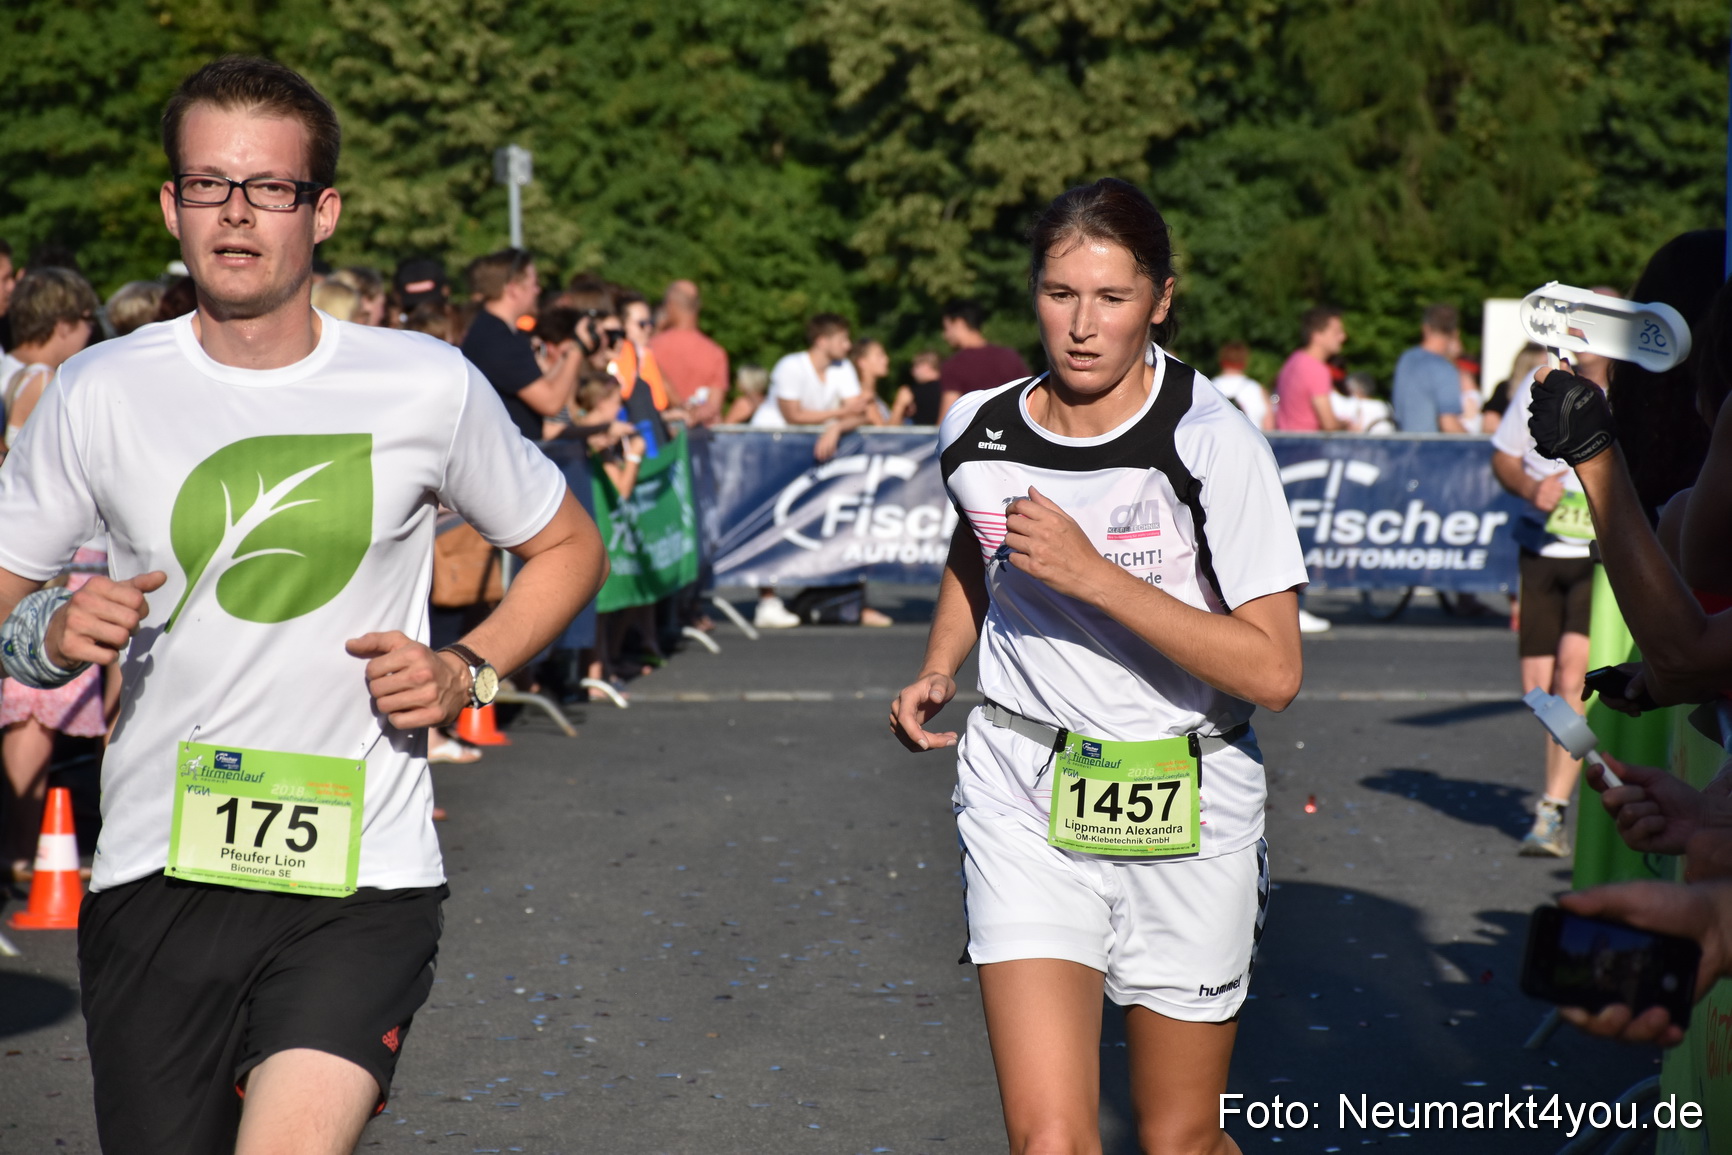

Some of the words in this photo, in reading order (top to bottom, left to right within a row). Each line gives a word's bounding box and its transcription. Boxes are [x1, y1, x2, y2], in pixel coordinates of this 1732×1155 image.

[978, 441, 1007, 451] erima
[1290, 499, 1509, 546] Fischer
[1304, 548, 1489, 570] AUTOMOBILE
[1072, 752, 1122, 769] firmenlauf
[201, 765, 266, 784] firmenlauf
[1127, 767, 1155, 777] 2018
[271, 783, 305, 797] 2018
[1069, 778, 1181, 823] 1457
[216, 797, 319, 853] 175
[1065, 818, 1122, 835] Lippmann
[1125, 824, 1183, 835] Alexandra
[1076, 833, 1144, 845] OM-Klebetechnik
[1145, 836, 1170, 845] GmbH
[220, 847, 271, 865] Pfeufer
[275, 854, 306, 868] Lion
[230, 863, 276, 877] Bionorica
[278, 868, 292, 878] SE
[1199, 974, 1242, 997] hummel
